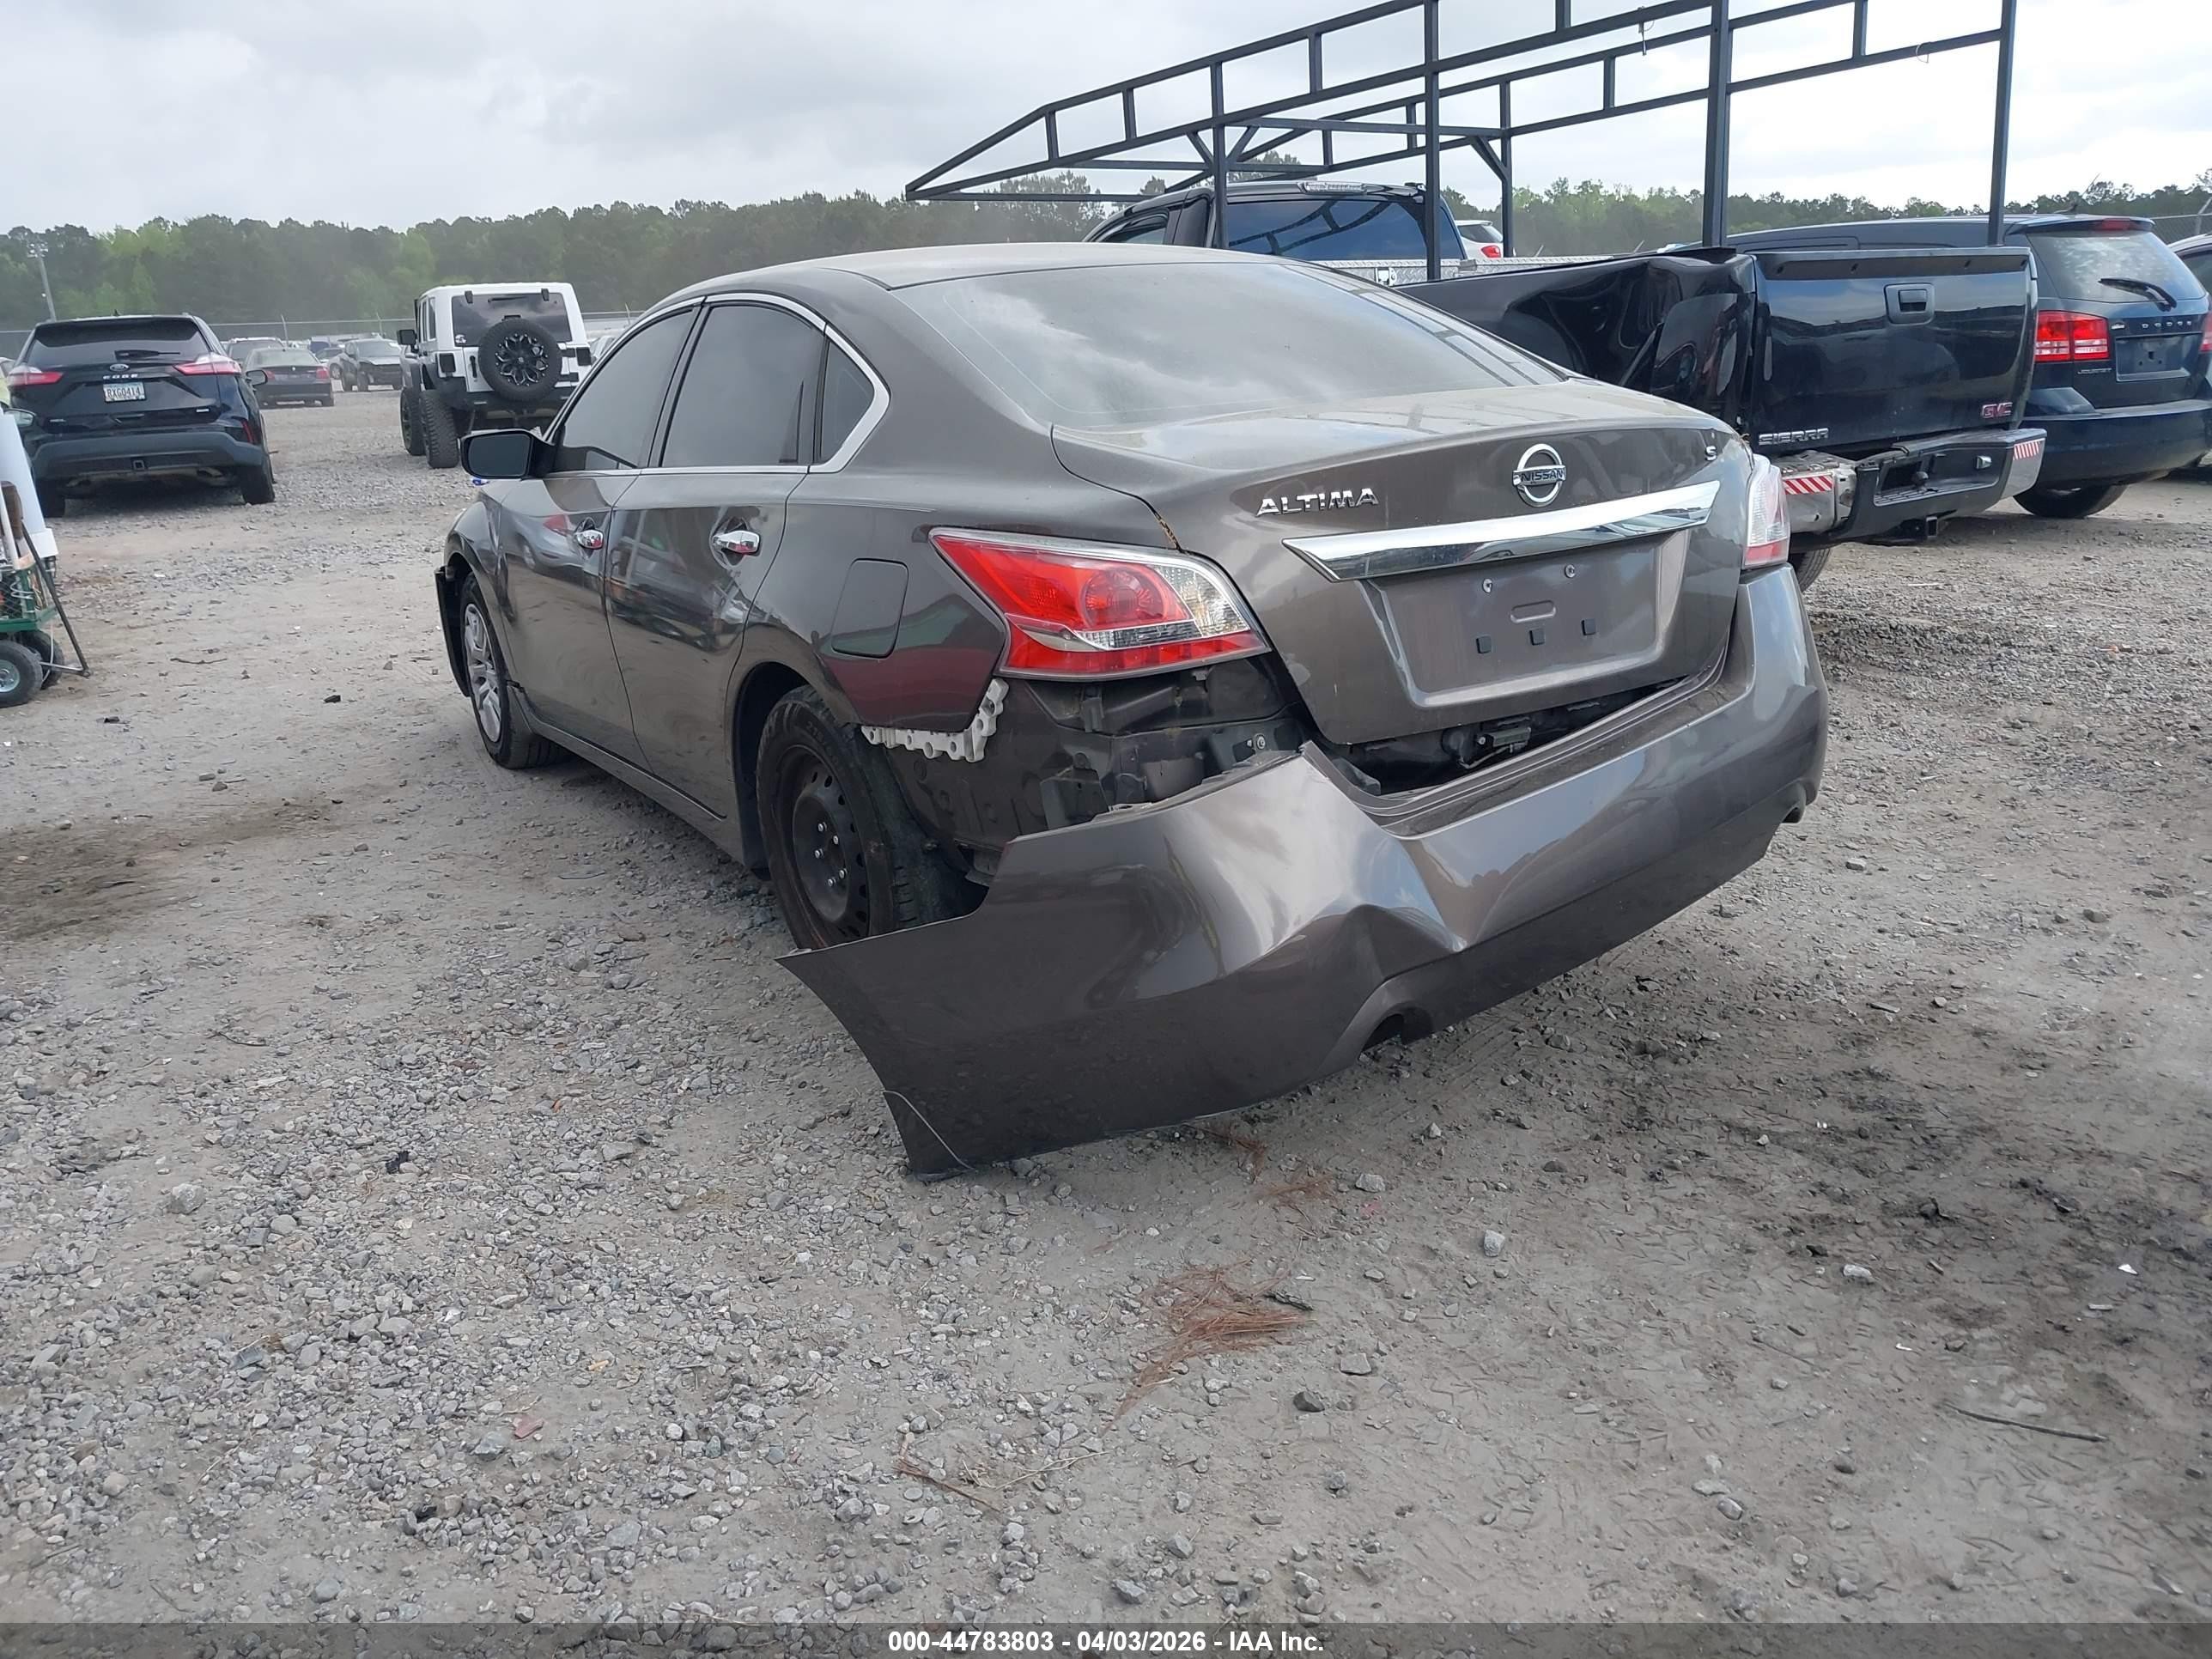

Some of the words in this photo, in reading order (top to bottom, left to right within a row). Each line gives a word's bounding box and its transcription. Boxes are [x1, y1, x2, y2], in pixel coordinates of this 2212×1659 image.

[1759, 428, 1829, 446] SIERRA
[1705, 446, 1717, 461] S
[1521, 470, 1564, 482] NISSAN
[1256, 488, 1379, 517] ALTIMA
